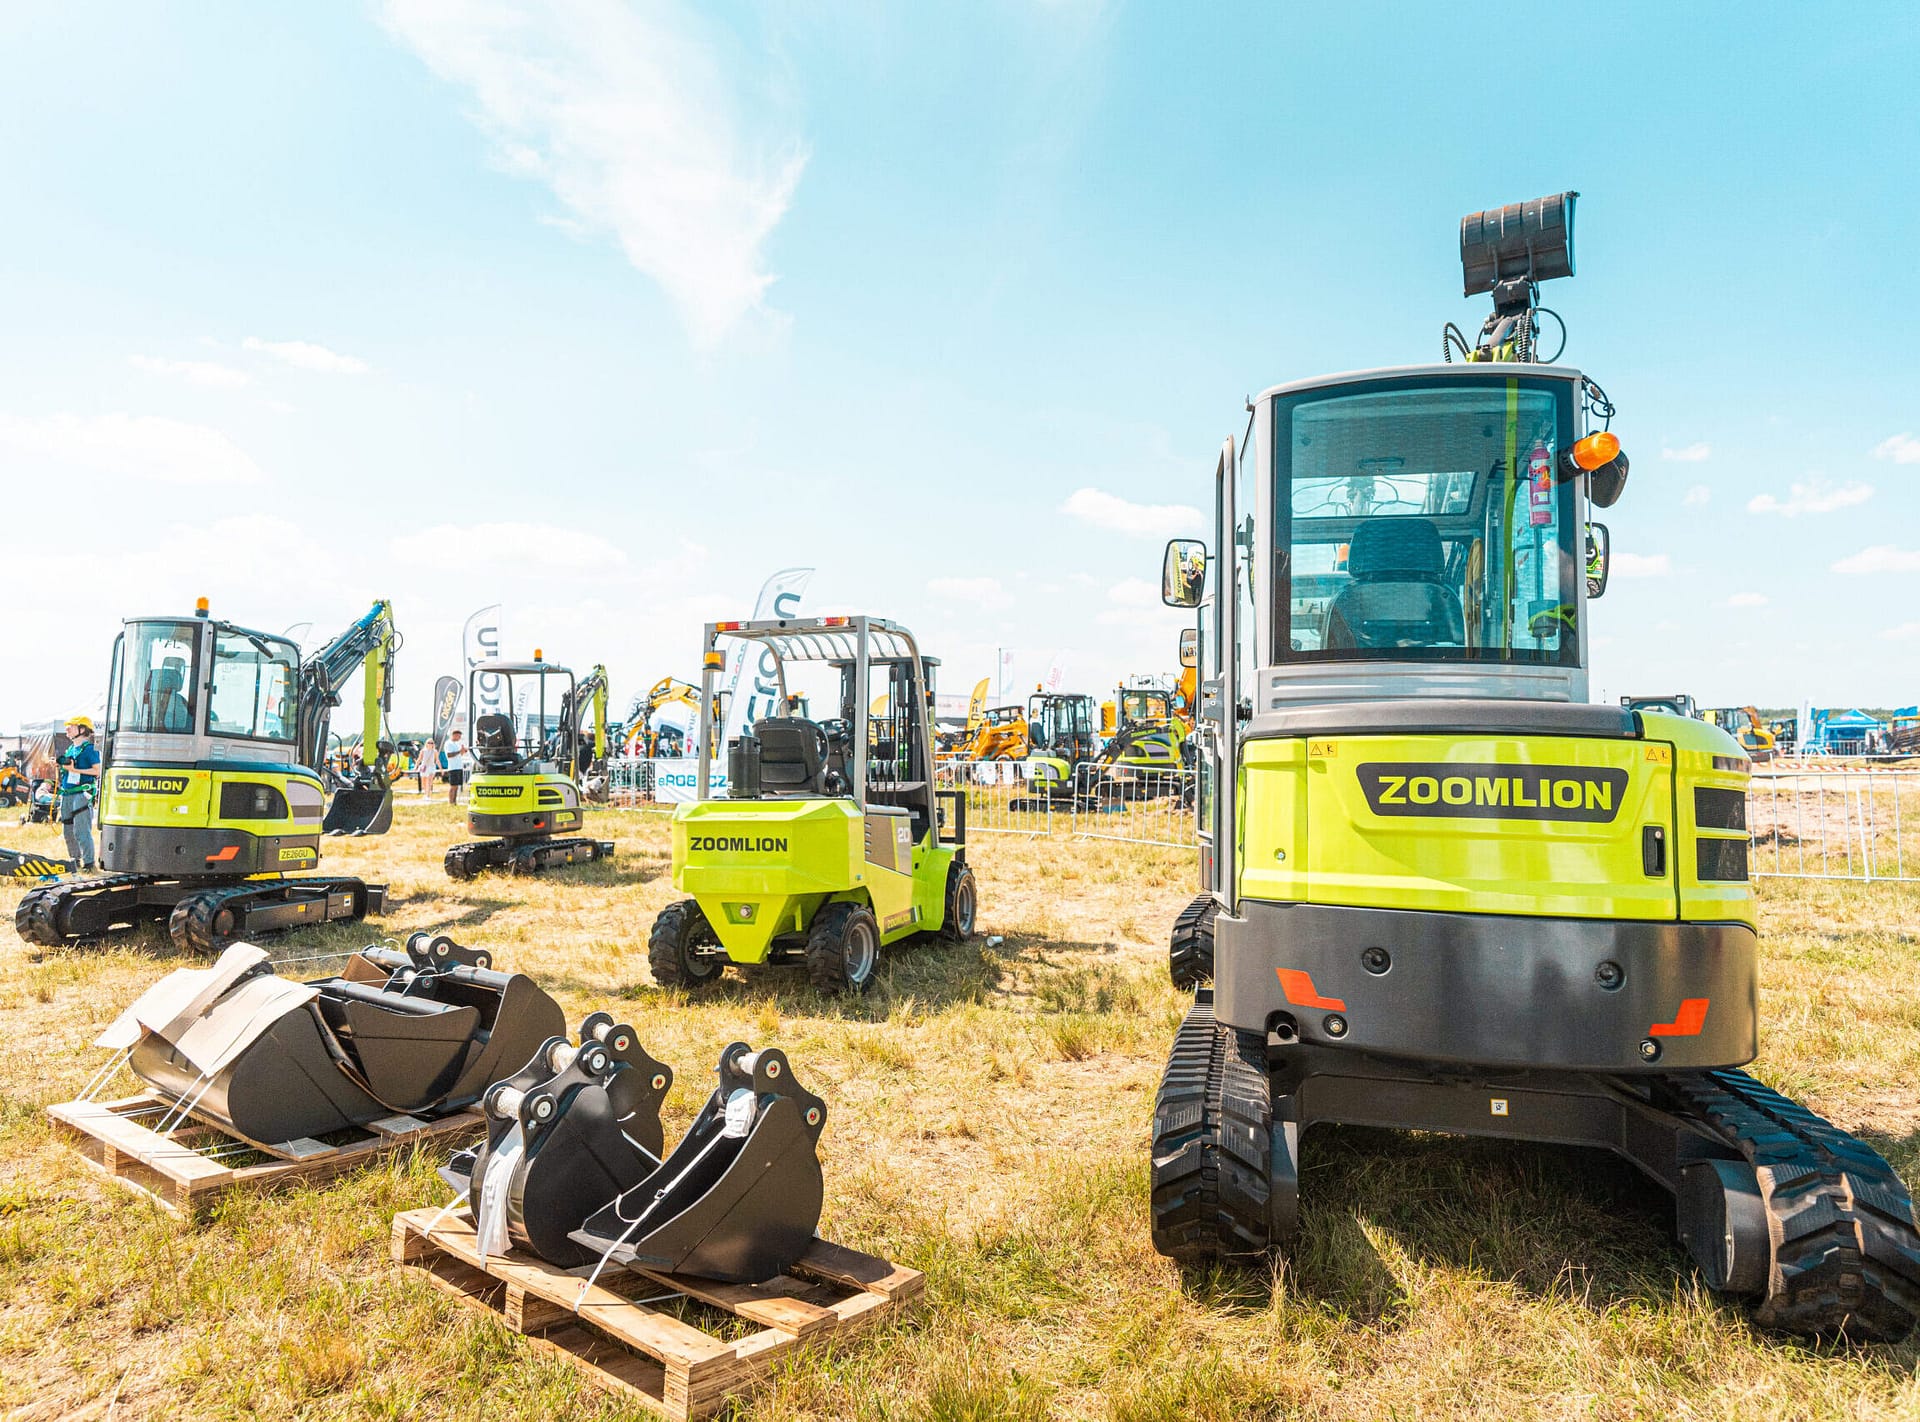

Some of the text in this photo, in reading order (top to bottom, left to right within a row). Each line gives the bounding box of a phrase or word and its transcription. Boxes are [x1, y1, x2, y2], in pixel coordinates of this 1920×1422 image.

[118, 778, 183, 791] ZOOMLION
[658, 774, 727, 788] eROBCZ
[478, 787, 520, 796] ZOOMLION
[1378, 776, 1612, 810] ZOOMLION
[690, 837, 788, 852] ZOOMLION
